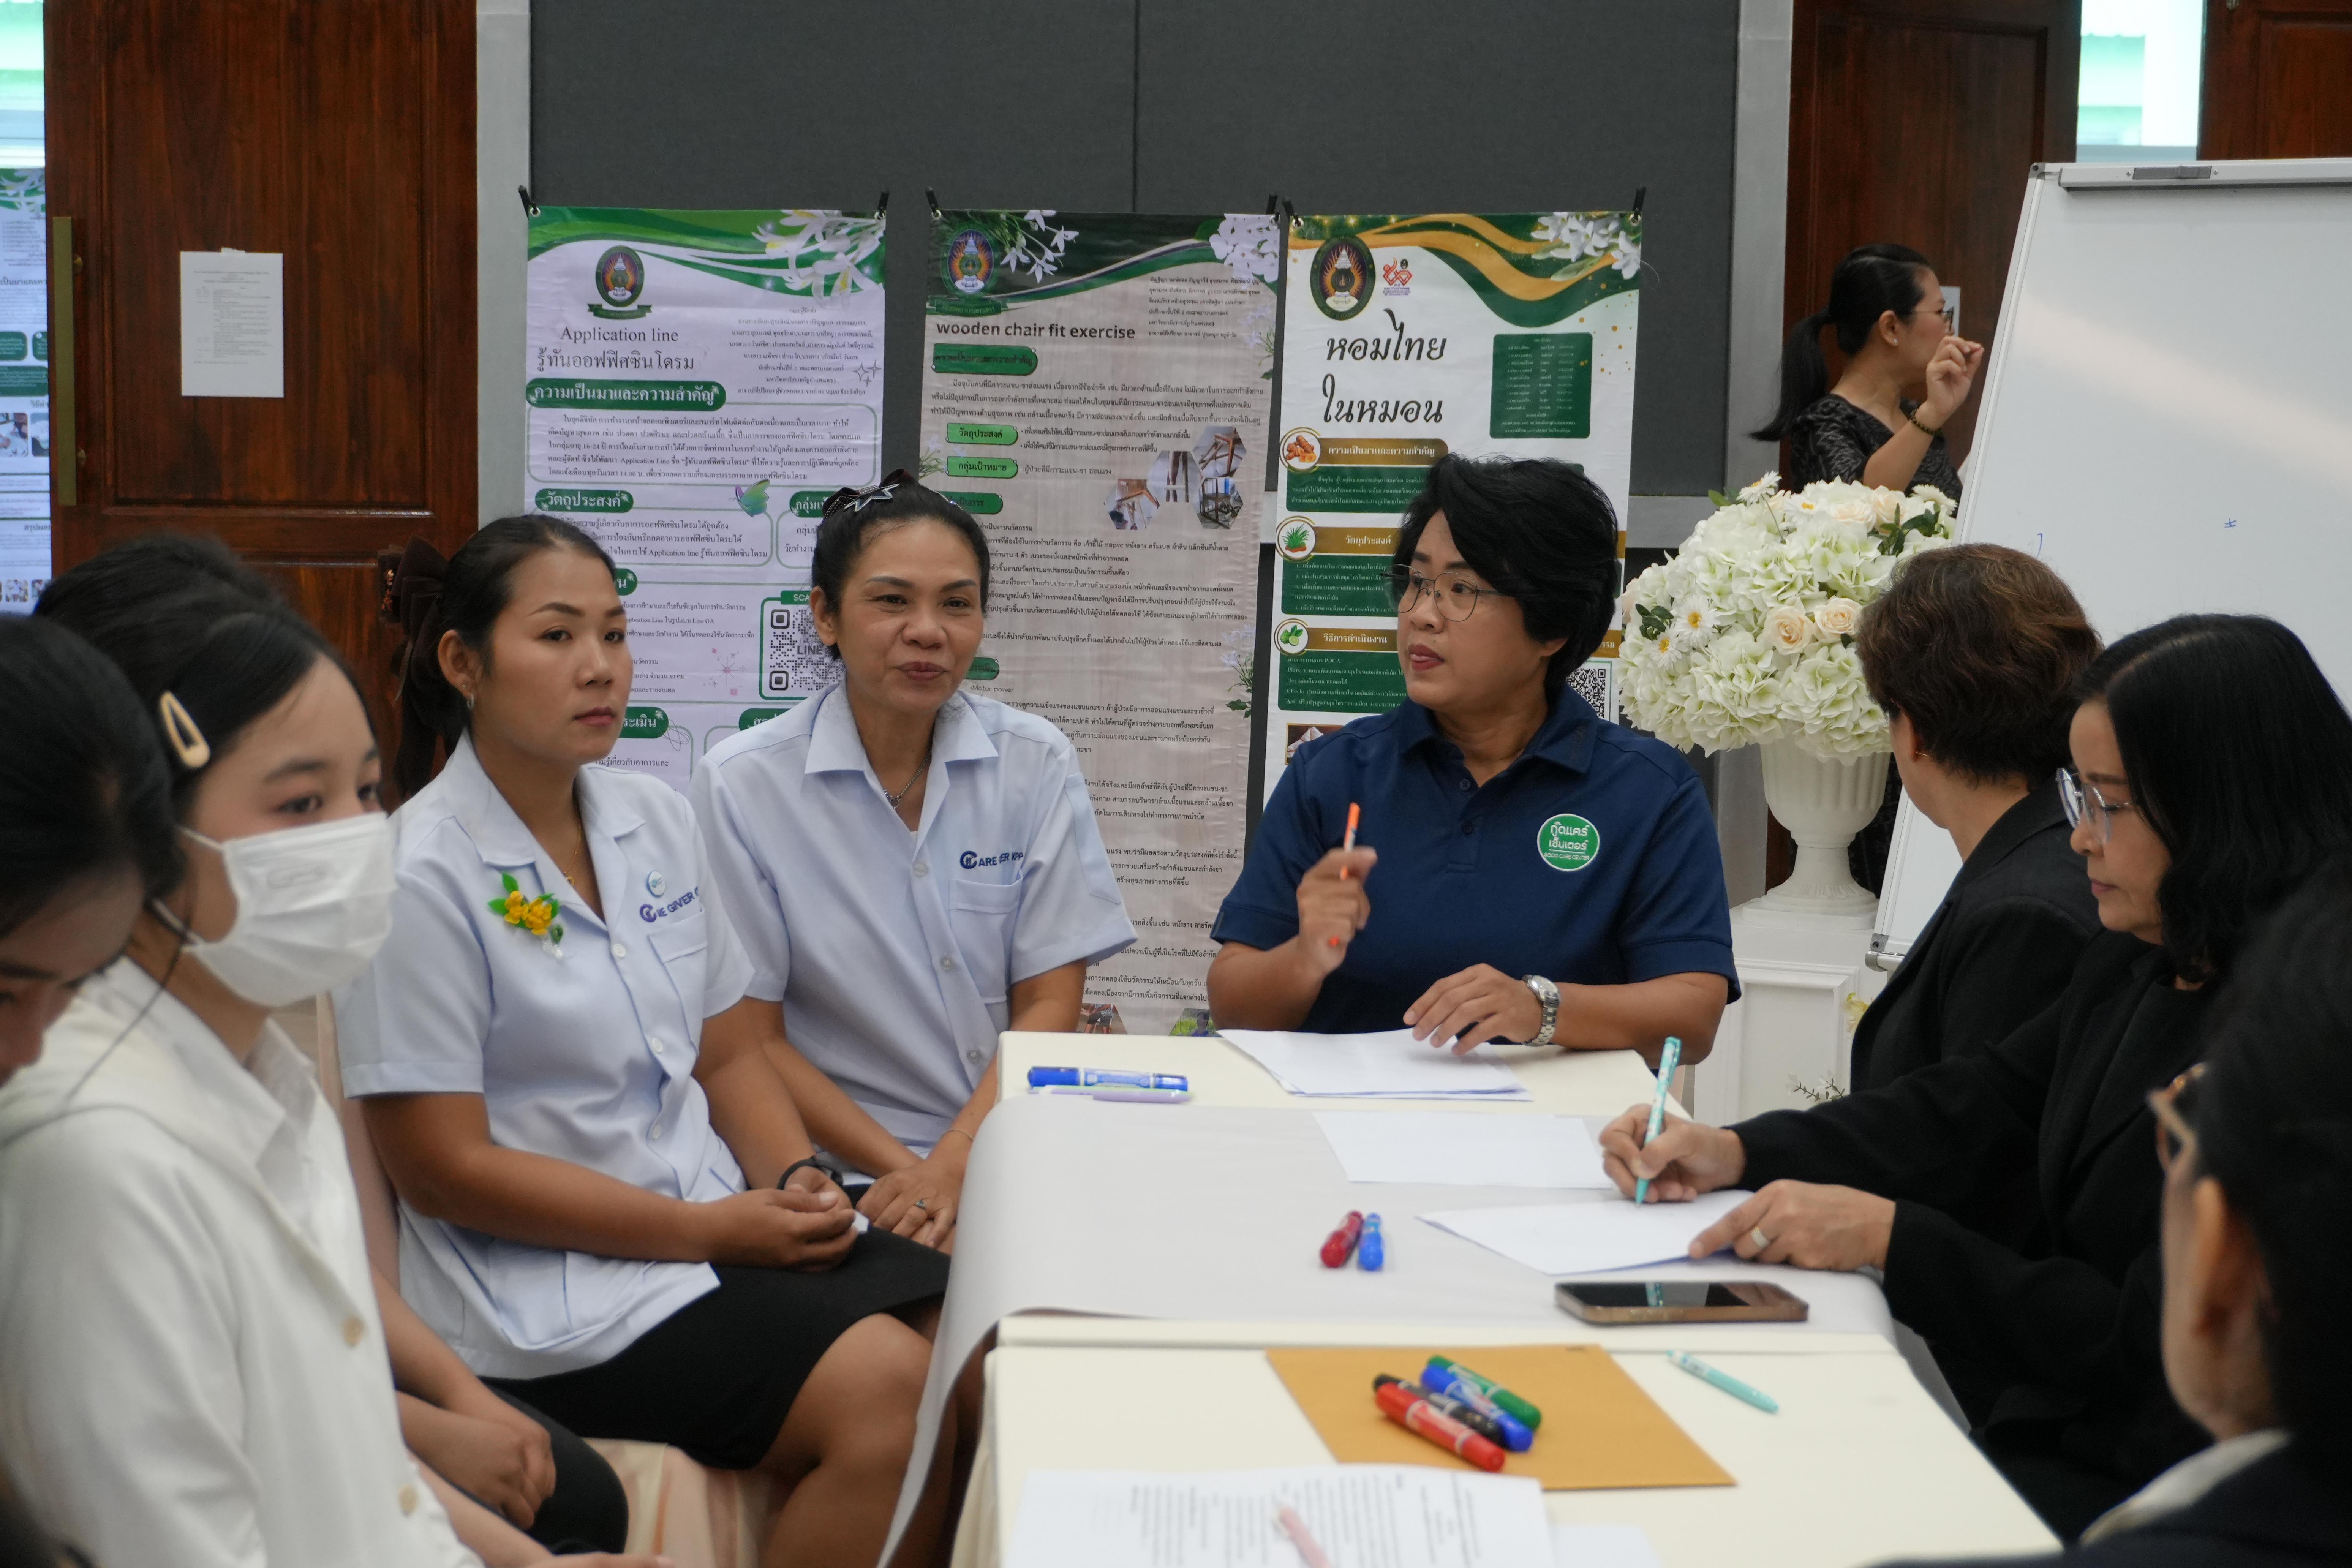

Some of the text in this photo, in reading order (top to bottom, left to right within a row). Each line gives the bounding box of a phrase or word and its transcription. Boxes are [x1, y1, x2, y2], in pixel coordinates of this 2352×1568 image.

[561, 327, 678, 345] Application line
[936, 321, 1136, 339] wooden chair fit exercise
[1326, 308, 1447, 362] หอมไทย
[536, 347, 694, 373] รู้ทันออฟฟิศซินโดรม
[953, 379, 1051, 389] ปัจจุบันคนที่มีภาวะแขน-ขาอ่อนแรง
[1054, 381, 1106, 390] เนื่องจากมีข้อจำกัด
[1121, 383, 1182, 393] มีมวลกล้ามเนื้อที่ลีบลง
[1184, 385, 1263, 395] ไม่มีเวลาในการออกกำลังกาย
[534, 383, 714, 406] ความเป็นมาและความสำคัญ
[931, 392, 1062, 404] หรือไม่มีอุปกรณ์ในการออกกำลังกายที่เหมาะสม
[1323, 373, 1443, 425] ในหมอน
[563, 414, 597, 424] ในยุคดิจิทัล
[833, 418, 850, 427] ทำให้
[931, 407, 1012, 419] ทำให้มีปัญหาทางด้านสุขภาพ
[1027, 408, 1075, 419] กล้ามเนื้อหดเกร็ง
[1076, 411, 1146, 420] มีความอ่อนแรงมากยิ่งขึ้น
[1148, 412, 1261, 426] และมีกล้ามเนื้อลีบมากขึ้นจากเดิมที่เป็นอยู่
[548, 427, 599, 438] เกิดปัญหาสุขภาพ
[640, 429, 670, 438] ปวดศีรษะ
[672, 428, 725, 439] และปวดกล้ามเนื้อ
[959, 427, 1003, 440] วัตถุประสงค์
[548, 440, 581, 450] ในกลุ่มอายุ
[1328, 445, 1435, 457] ความเป็นมาและความสำคัญ
[548, 454, 617, 464] คณะผู้จัดทำจึงได้พัฒนา
[671, 455, 680, 464] ชื่อ
[548, 466, 618, 477] โดยแจ้งเตือนทุกวันเวลา
[959, 461, 1007, 476] กลุ่มเป้าหมาย
[547, 490, 621, 510] วัตถุประสงค์
[1083, 538, 1103, 547] เก้าอี้ไม้
[1345, 535, 1392, 547] วัตถุประสงค์
[700, 548, 767, 559] รู้ทันออฟฟิศซินโดรม
[1030, 551, 1129, 562] เบาะรองนั่งและพนักพิงที่ทำจากหลอด
[1031, 578, 1233, 592] โดยส่วนประกอบในส่วนตัวเบาะรองนั่ง พนักพิงและที่รองขาทำจากหลอดทั้งหมด
[664, 616, 691, 624] ในรูปแบบ
[1142, 610, 1247, 621] ได้ข้อเสนอแนะจากผู้ป่วยที่ได้ทำการทดลอง
[1323, 633, 1387, 644] วิธีการดำเนินงาน
[797, 645, 823, 655] LINE
[1106, 703, 1214, 714] ถ้าผู้ป่วยมีอาการอ่อนแรงแขนและขาข้างที่
[1091, 717, 1214, 729] ทำไม่ได้ตามที่ผู้ตรวจร่างกายบอกหรือพอขยับยก
[1112, 795, 1233, 807] สามารถบริหารกล้ามเนื้อแขนและกล้ามเนื้อขา
[1550, 821, 1590, 837] กู๊ดแคร์
[1549, 837, 1589, 850] เซ็นเตอร์
[959, 850, 997, 869] CARE
[1124, 848, 1224, 859] พบว่ามีผลตรงตามวัตถุประสงค์ที่ตั้งไว้
[1172, 920, 1192, 928] หนังยาง
